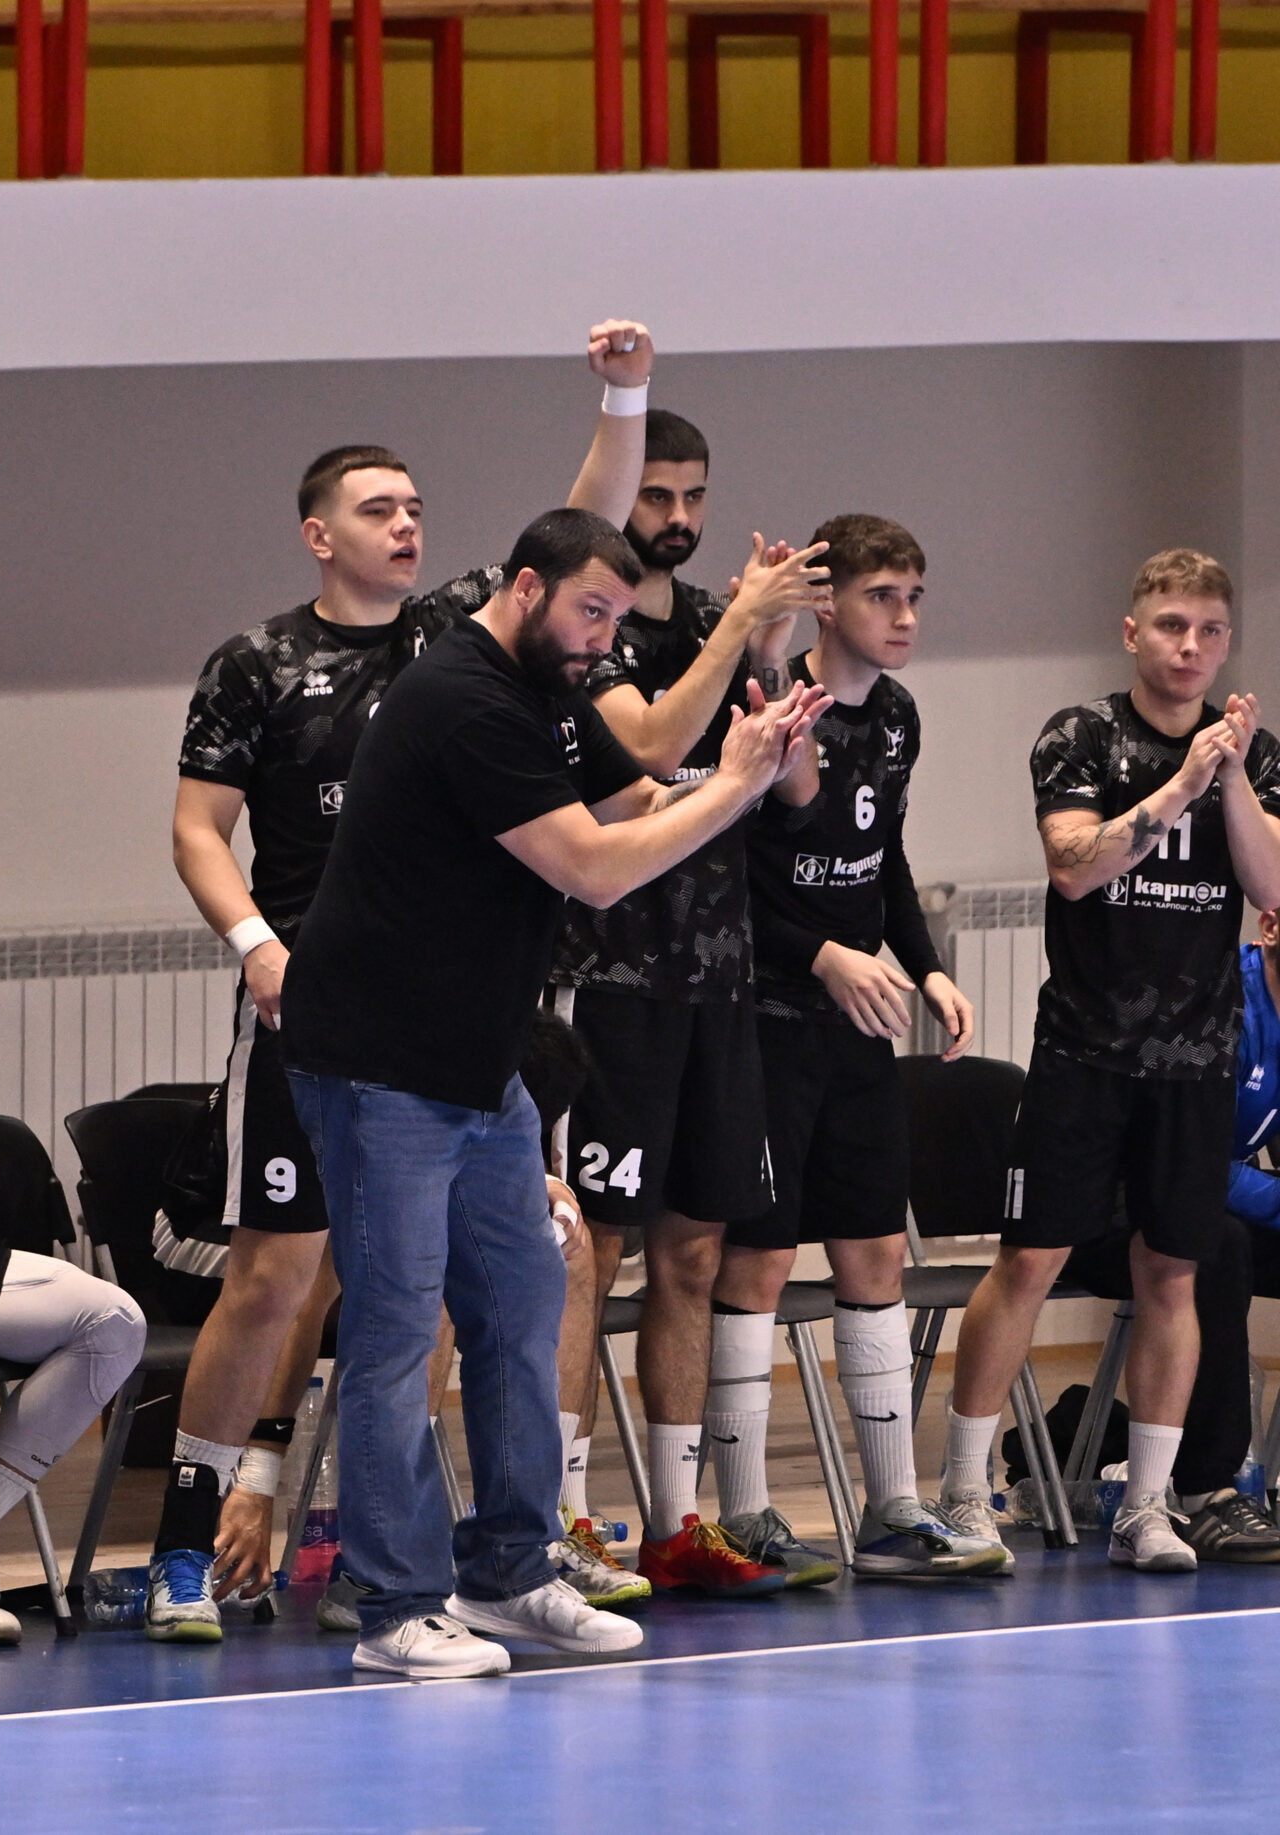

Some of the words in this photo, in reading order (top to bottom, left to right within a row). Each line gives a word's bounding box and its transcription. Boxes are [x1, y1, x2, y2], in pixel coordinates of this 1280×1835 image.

[855, 784, 876, 831] 6
[264, 1156, 297, 1203] 9
[578, 1141, 644, 1198] 24
[304, 1525, 323, 1538] sa
